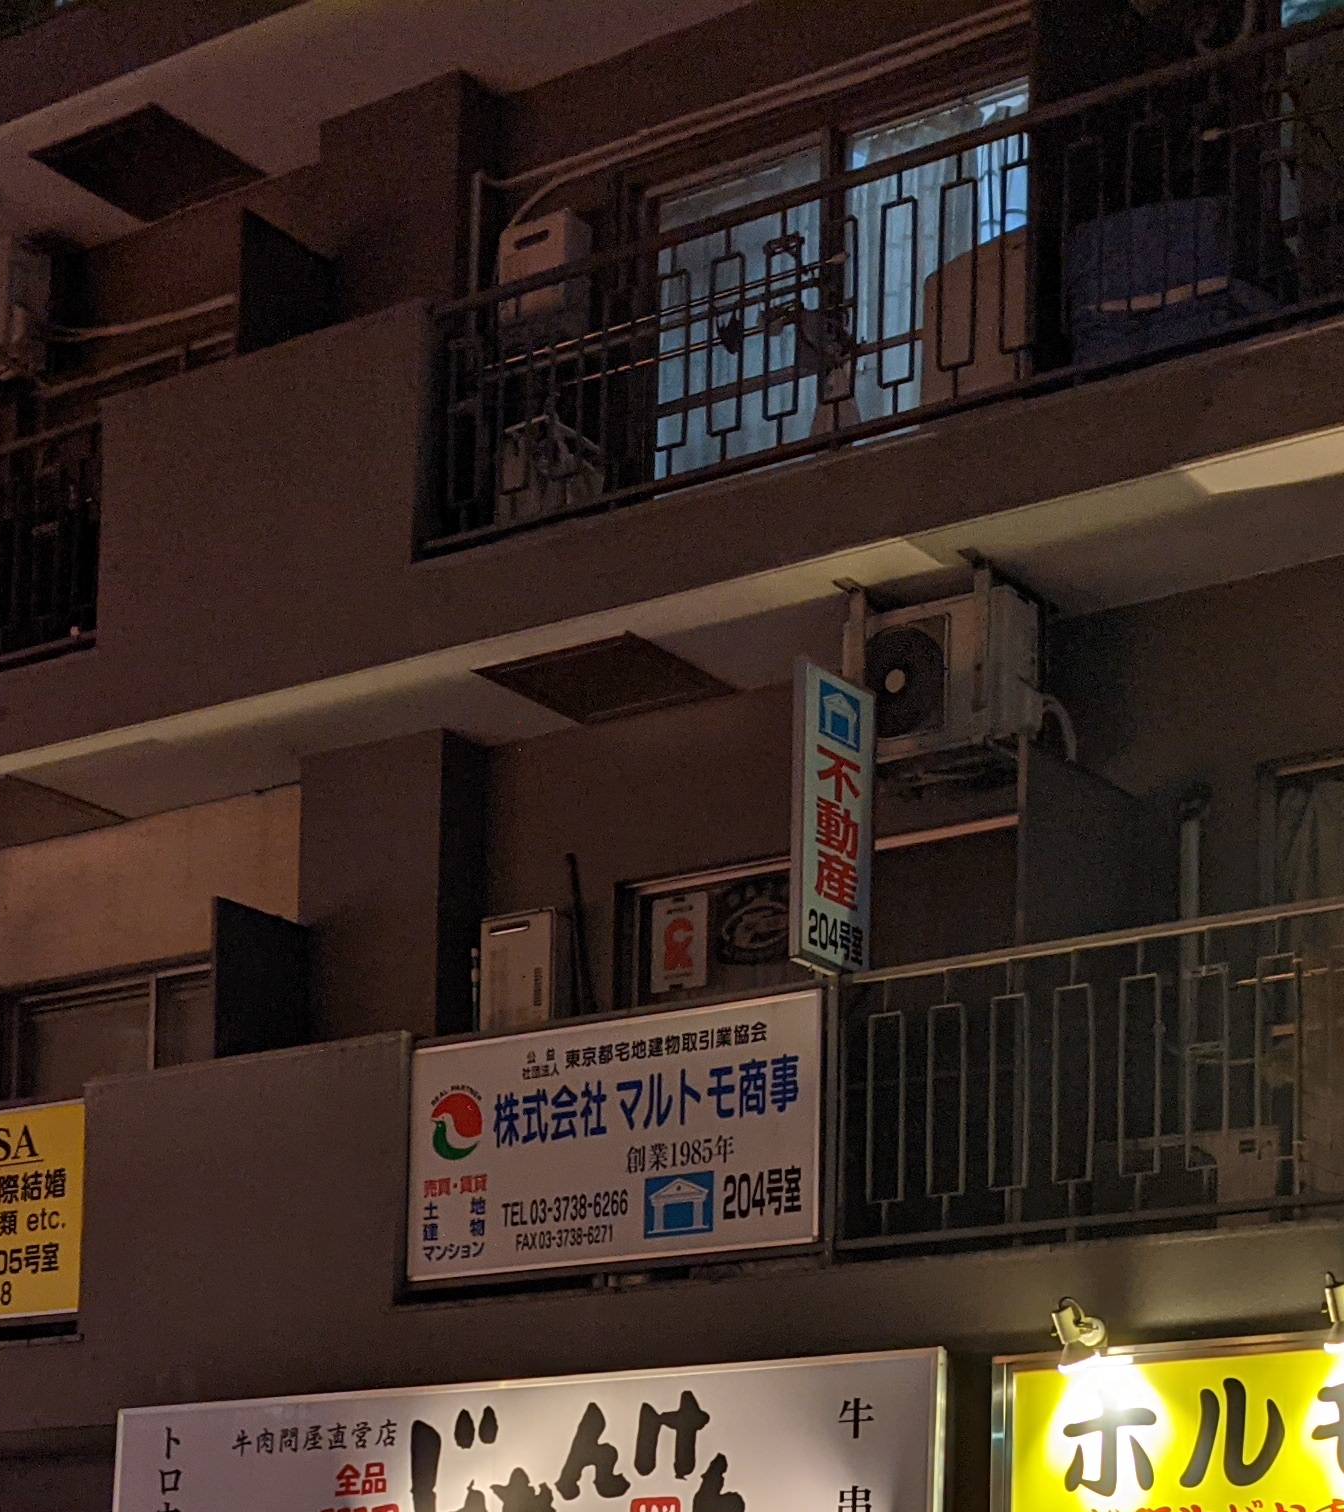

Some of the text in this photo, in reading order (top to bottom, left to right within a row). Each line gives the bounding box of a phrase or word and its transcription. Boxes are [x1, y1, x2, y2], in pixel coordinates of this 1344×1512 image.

[814, 743, 861, 912] 不動産
[807, 908, 863, 967] 204号室
[565, 1020, 768, 1069] 東京都宅地建物取引業協会
[493, 1053, 800, 1148] 株式会社 マルトモ商事
[625, 1134, 734, 1174] 創業1985年
[501, 1189, 629, 1228] TEL 03-3738-6266
[723, 1165, 803, 1220] 204号室
[27, 1211, 66, 1233] etc.
[516, 1227, 614, 1252] FAX 03-3738-6271
[423, 1241, 485, 1261] マンション
[231, 1419, 398, 1458] 牛肉問屋直営店
[335, 1462, 387, 1497] 全品
